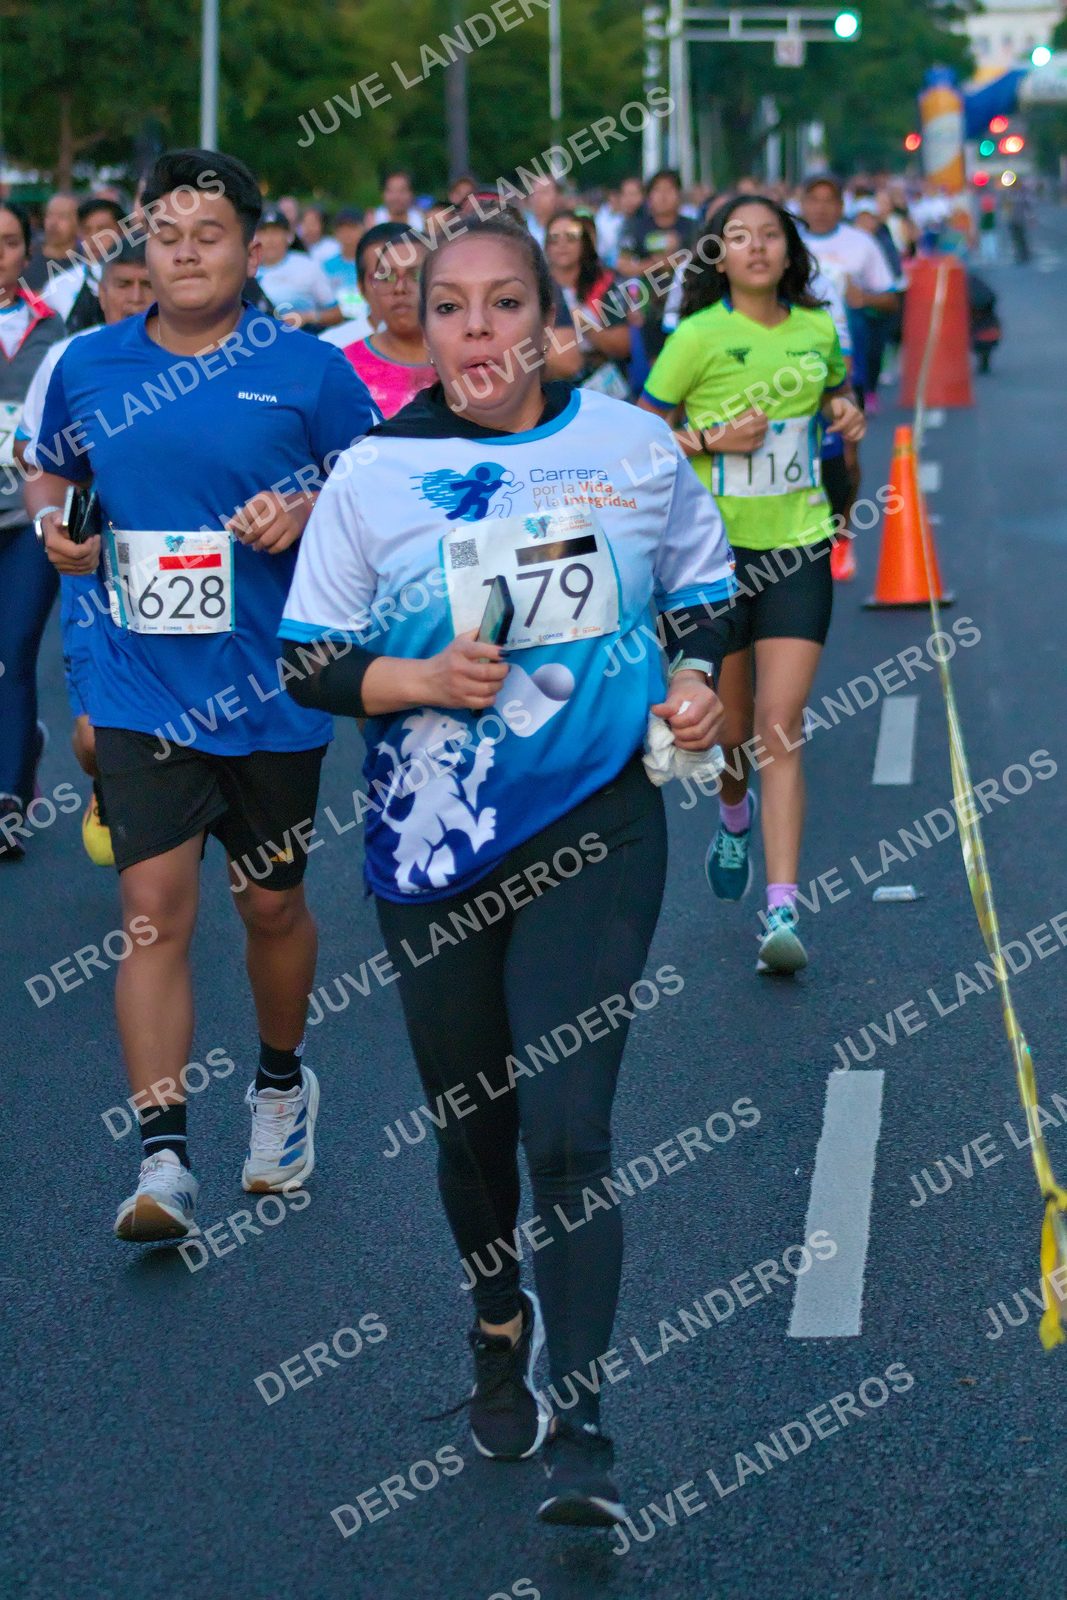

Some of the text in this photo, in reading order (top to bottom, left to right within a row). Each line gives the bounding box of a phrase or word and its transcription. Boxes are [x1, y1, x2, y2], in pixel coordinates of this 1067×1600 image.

[529, 468, 608, 483] Carrera
[532, 480, 614, 498] por la Vida
[534, 495, 638, 510] y la Integridad
